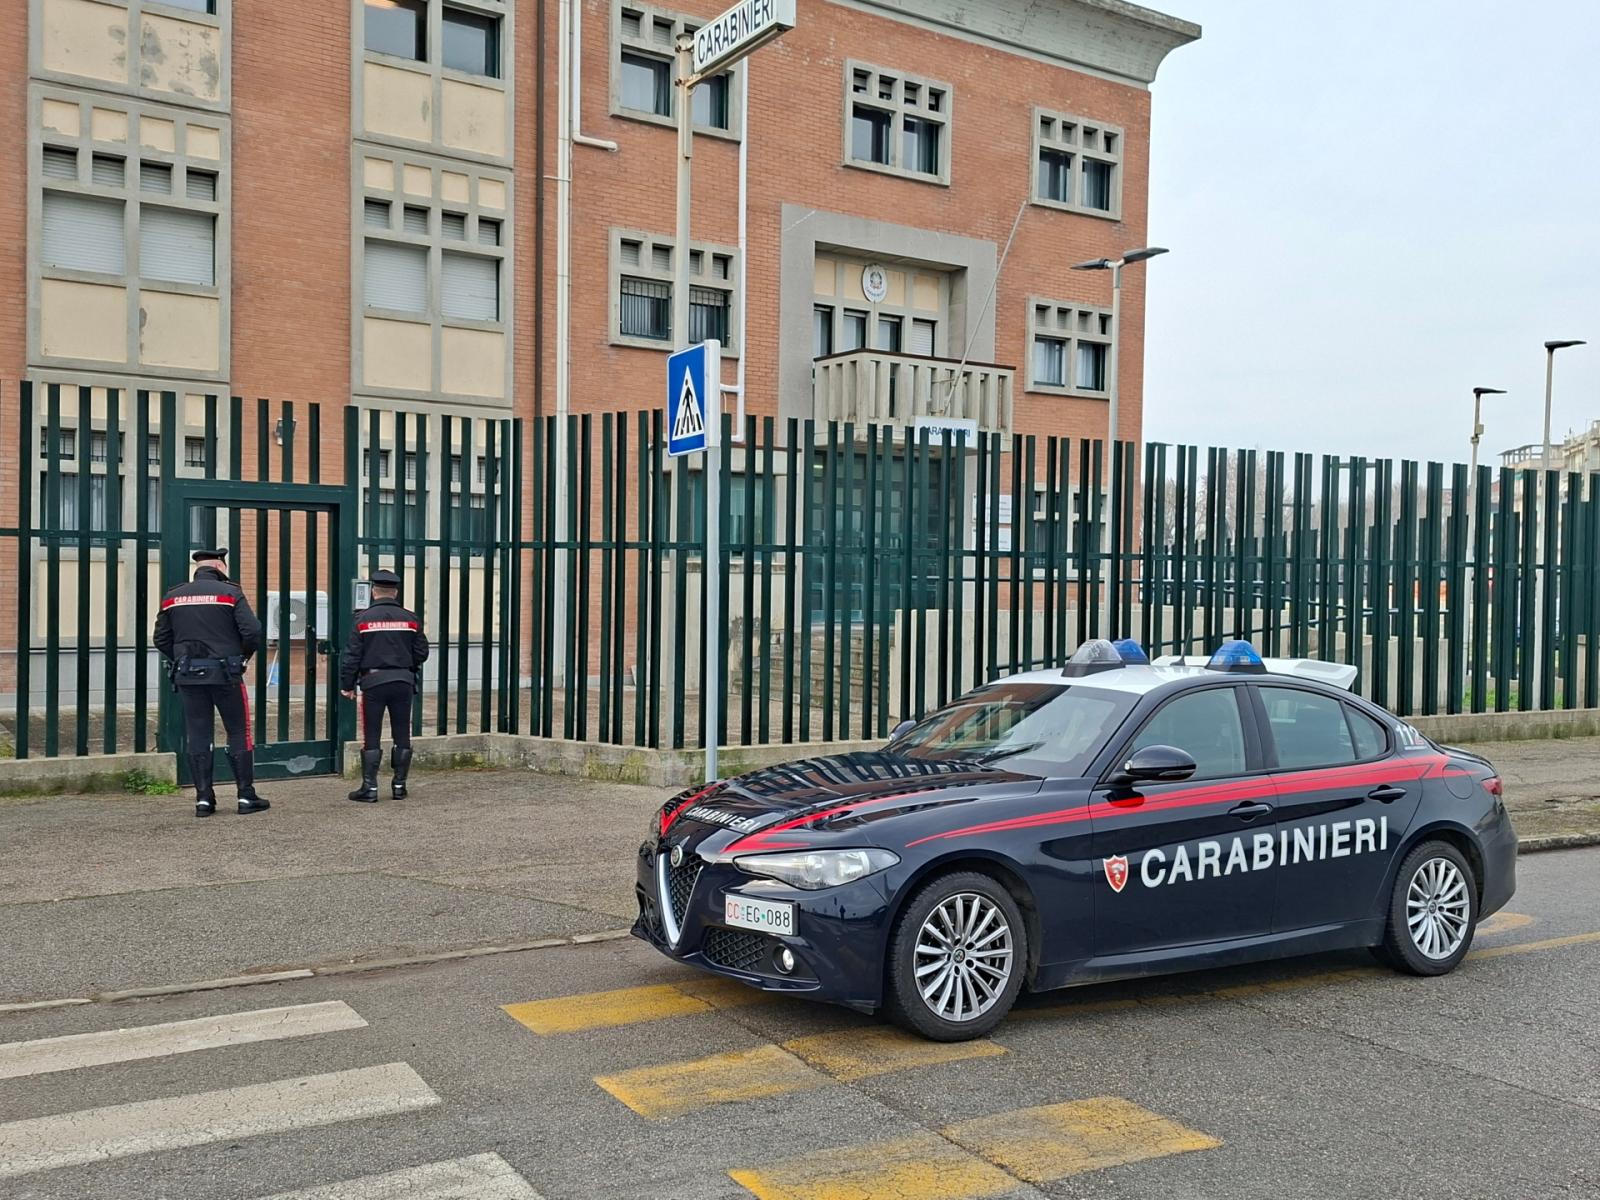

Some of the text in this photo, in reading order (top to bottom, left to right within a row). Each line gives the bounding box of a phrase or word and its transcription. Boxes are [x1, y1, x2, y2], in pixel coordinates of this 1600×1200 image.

[698, 0, 774, 63] CARABINIERI
[173, 595, 218, 604] CARABINIERI
[367, 621, 409, 629] CARABINIERI
[685, 806, 761, 831] CARABINIERI
[1140, 816, 1388, 888] CARABINIERI
[727, 902, 790, 928] CC EG 088
